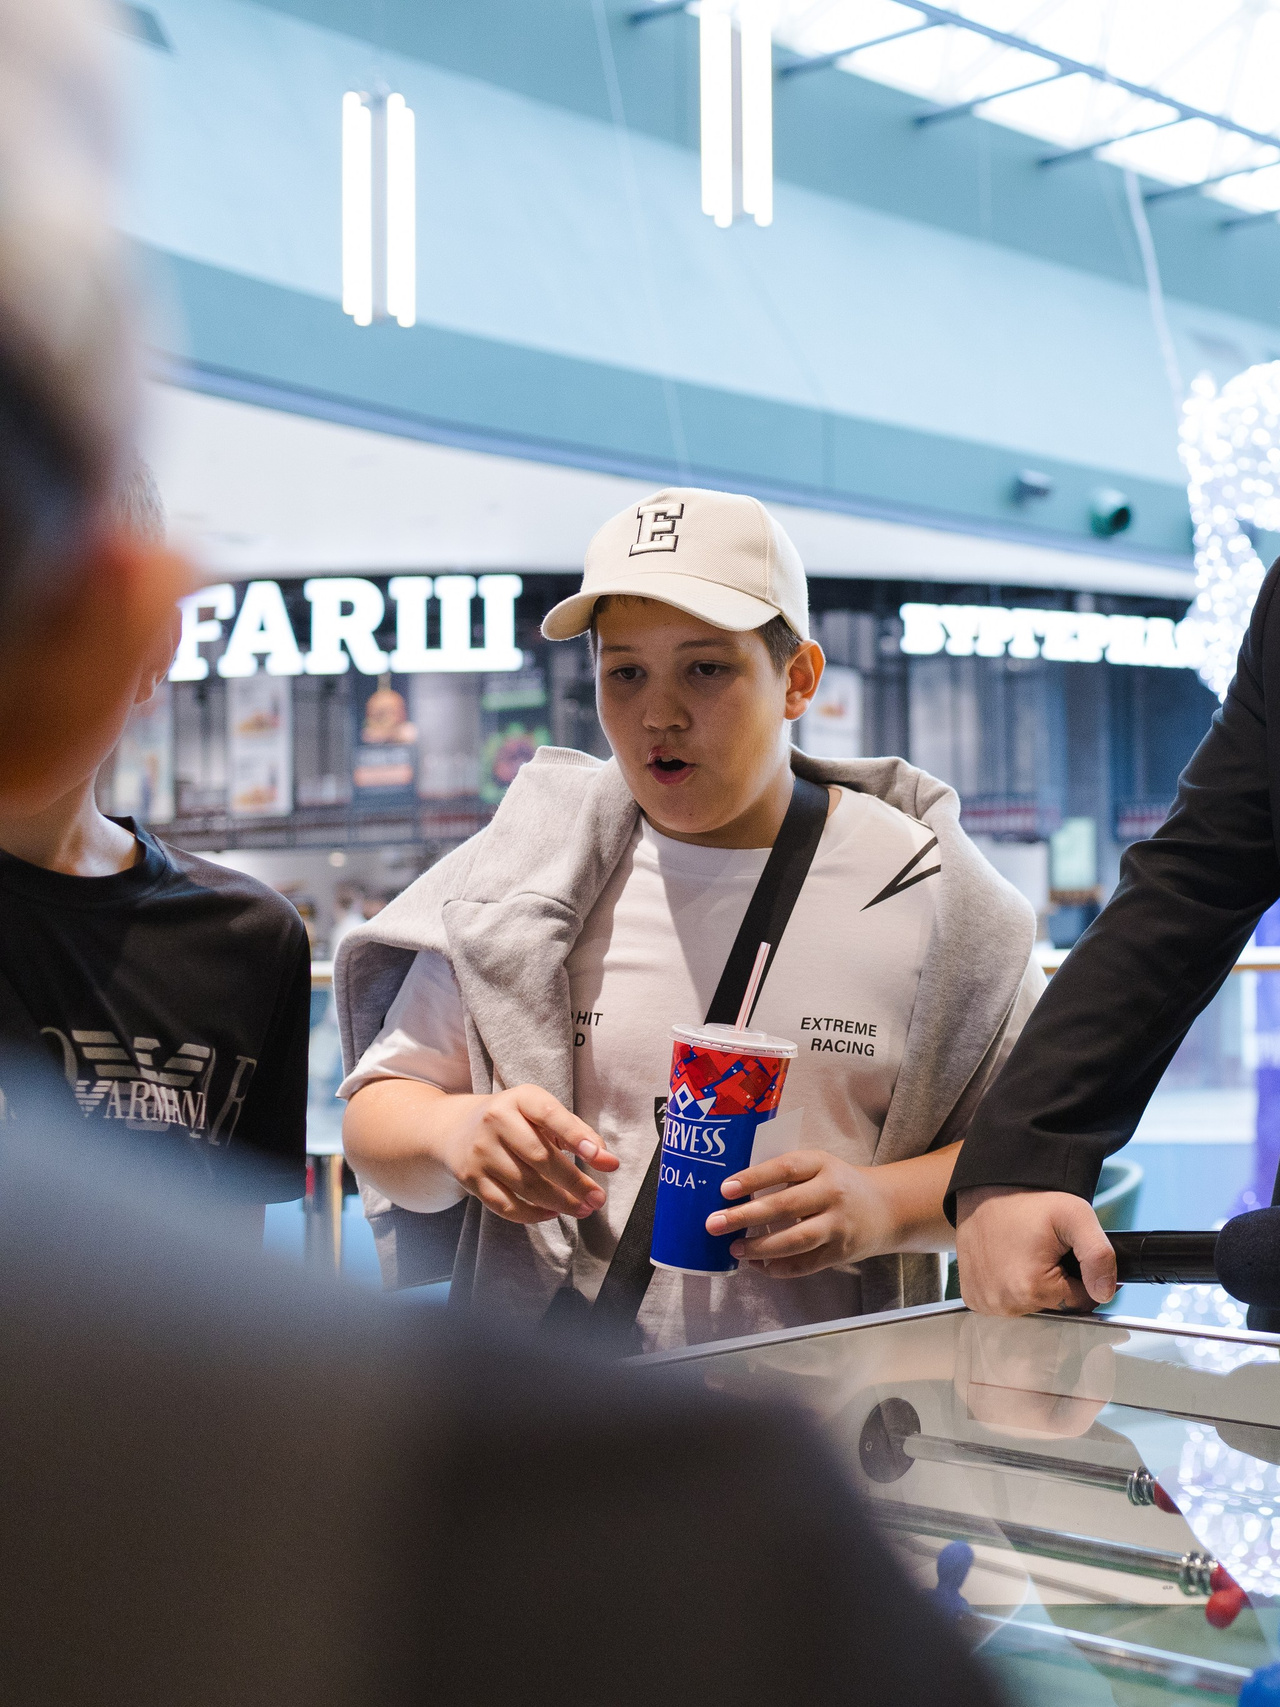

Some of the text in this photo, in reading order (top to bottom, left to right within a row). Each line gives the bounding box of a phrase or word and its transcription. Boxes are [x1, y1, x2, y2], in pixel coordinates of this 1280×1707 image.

[628, 503, 685, 557] E
[800, 1017, 877, 1038] EXTREME
[810, 1038, 875, 1057] RACING
[103, 1080, 207, 1130] ARMANI
[663, 1118, 727, 1157] ERVESS
[660, 1163, 696, 1190] COLA
